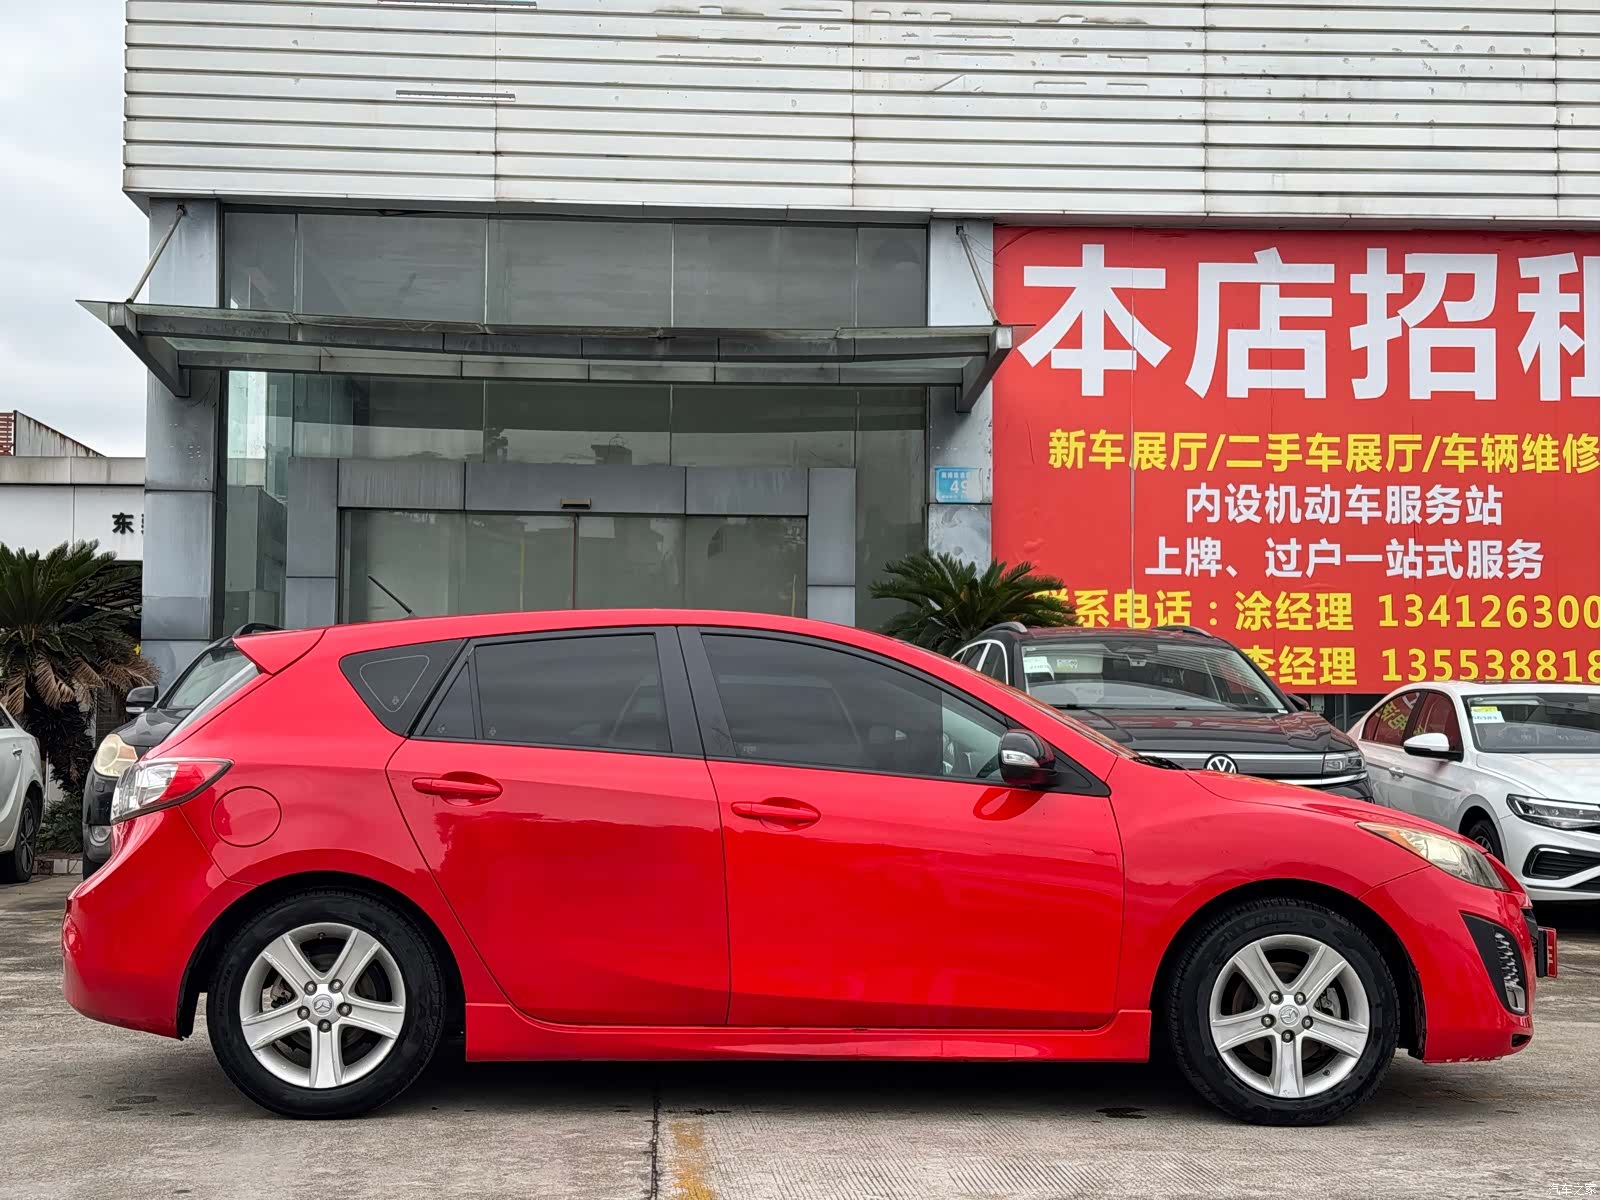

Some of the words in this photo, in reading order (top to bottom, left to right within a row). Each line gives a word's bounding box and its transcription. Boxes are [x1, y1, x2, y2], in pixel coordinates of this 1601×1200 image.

[1048, 429, 1601, 474] 新车展厅/二手车展厅/车辆维修
[112, 512, 144, 535] 东
[1185, 483, 1503, 526] 内设机动车服务站
[1144, 536, 1544, 580] 上牌、过户一站式服务
[1378, 593, 1601, 629] 134126300
[1382, 648, 1601, 683] 135538818
